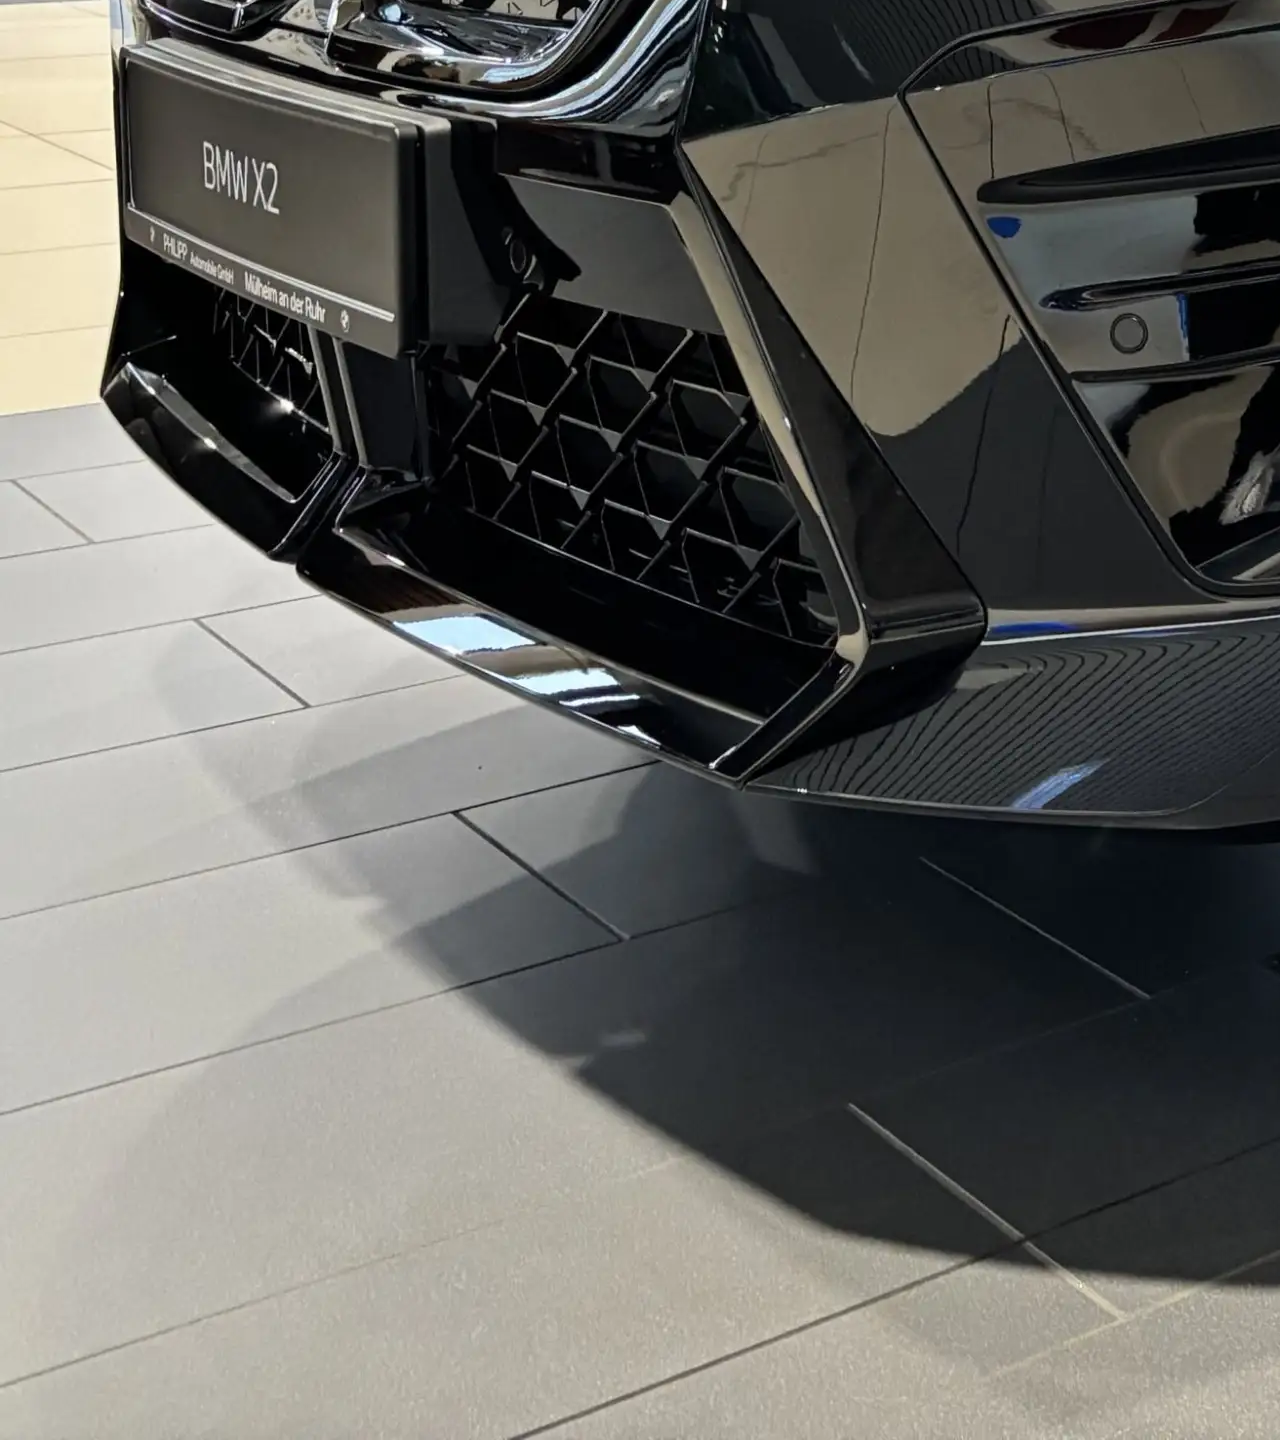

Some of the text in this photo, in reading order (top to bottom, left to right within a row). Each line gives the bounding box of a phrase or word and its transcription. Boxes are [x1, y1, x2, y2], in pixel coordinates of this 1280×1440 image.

[203, 140, 280, 215] BMW X2
[163, 232, 188, 261] PHILIPP
[244, 271, 278, 304] Mülheim
[278, 291, 290, 309] an
[290, 291, 304, 313] der
[305, 297, 326, 324] Ruhr
